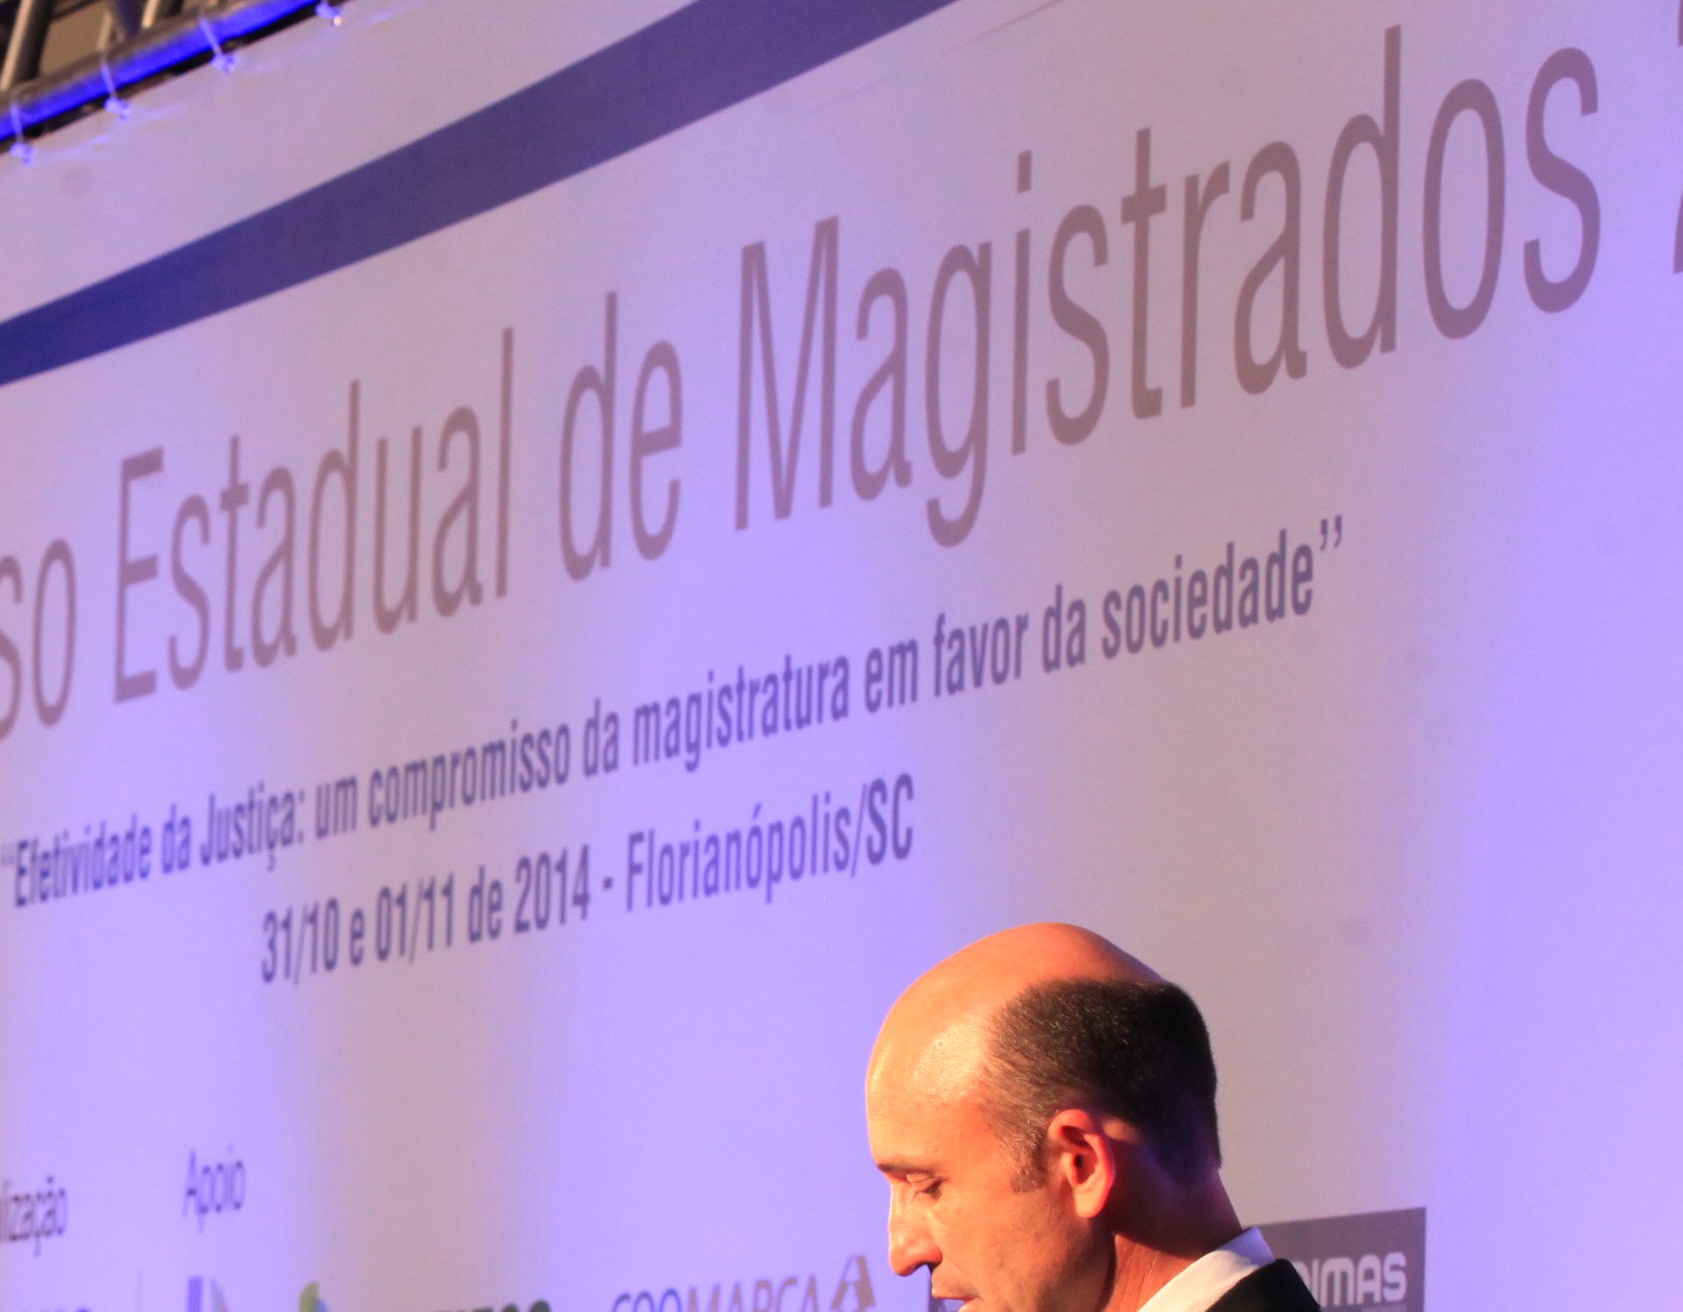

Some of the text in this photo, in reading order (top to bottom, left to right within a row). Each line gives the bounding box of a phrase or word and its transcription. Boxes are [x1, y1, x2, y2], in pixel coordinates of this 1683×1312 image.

[113, 325, 515, 706] Estadual
[557, 290, 684, 581] de
[733, 24, 1602, 549] Magistrados
[161, 802, 192, 875] da
[200, 781, 305, 872] Justiça:
[315, 774, 358, 839] um
[368, 717, 571, 832] compromisso
[582, 697, 619, 778] da
[633, 653, 850, 773] magistratura
[864, 637, 918, 714] em
[933, 612, 1029, 698] favor
[1042, 583, 1086, 674] da
[260, 897, 340, 986] 31/10
[349, 907, 365, 966] e
[375, 871, 455, 964] 01/11
[467, 864, 503, 944] de
[514, 843, 591, 934] 2014
[625, 772, 914, 913] Florianópolis/SC
[182, 1144, 247, 1234] Apoio
